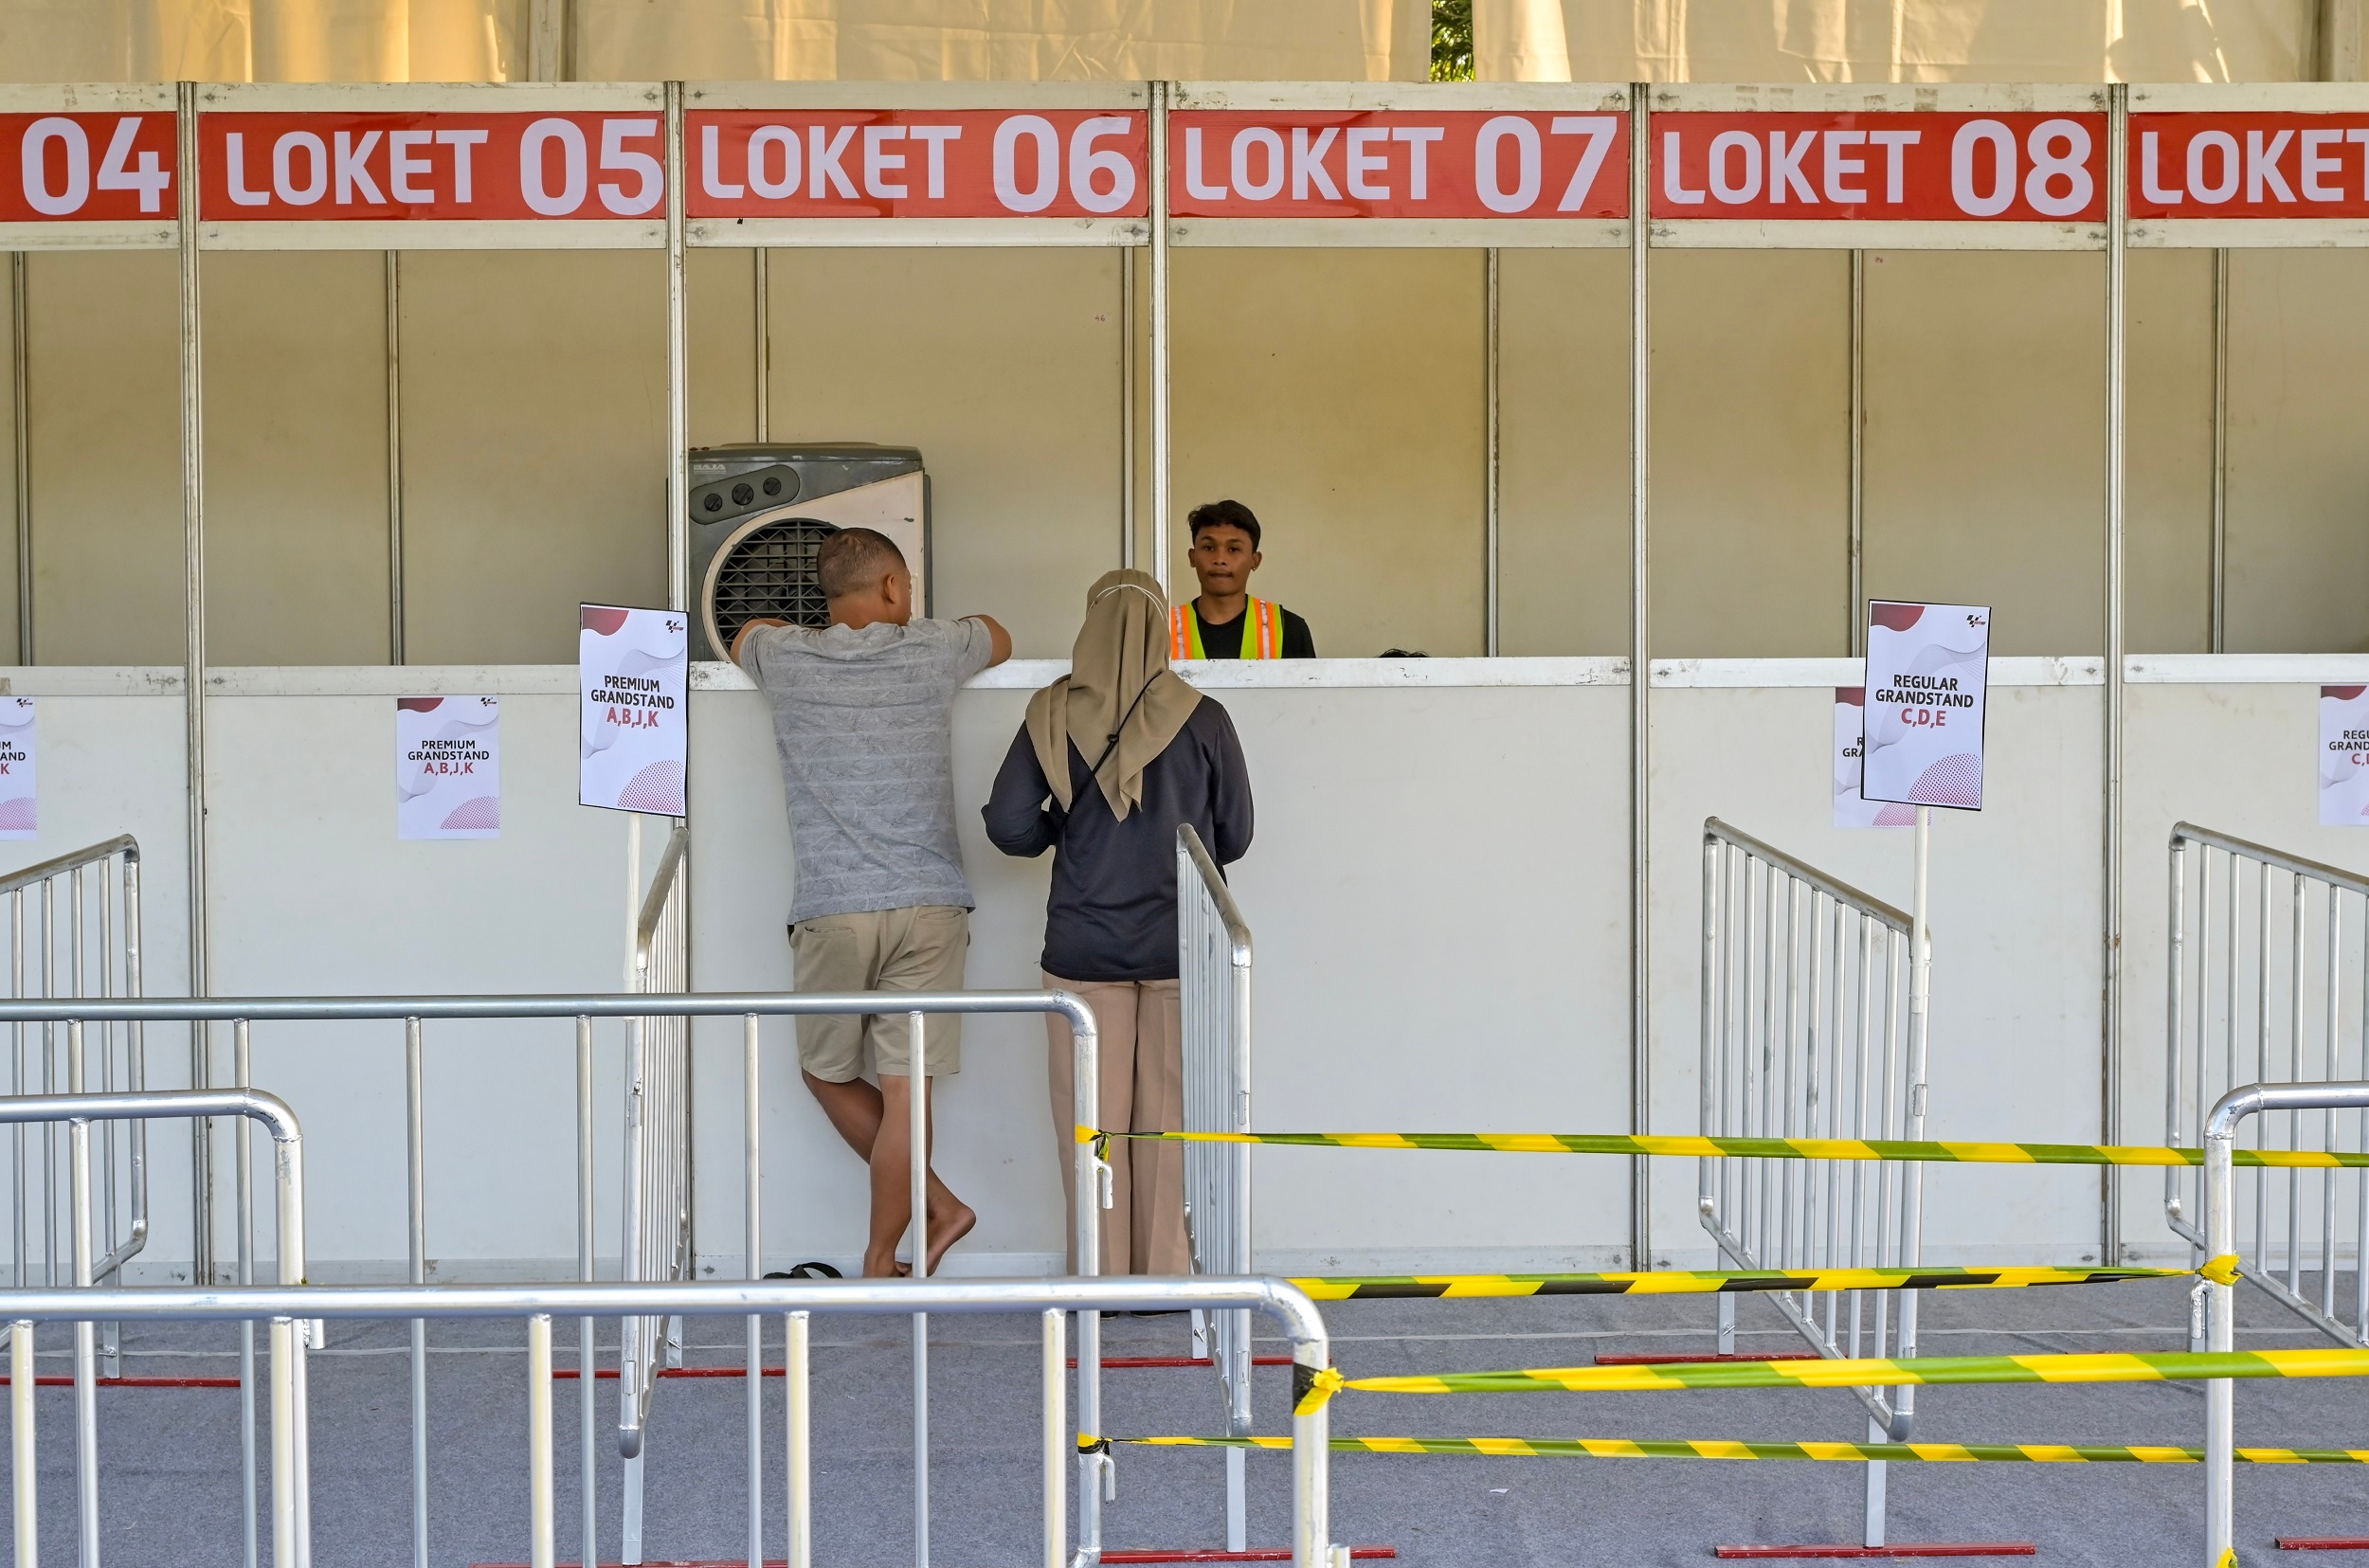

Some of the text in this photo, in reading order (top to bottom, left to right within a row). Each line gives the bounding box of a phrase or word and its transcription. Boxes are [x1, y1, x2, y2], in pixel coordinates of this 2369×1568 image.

[22, 117, 171, 215] 04
[226, 117, 664, 216] LOKET 05
[701, 115, 1136, 213] LOKET 06
[1185, 115, 1618, 212] LOKET 07
[1664, 118, 2093, 217] LOKET 08
[604, 675, 660, 693] PREMIUM
[1893, 674, 1959, 692] REGULAR
[590, 689, 675, 710] GRANDSTAND
[1875, 688, 1974, 709] GRANDSTAND
[606, 706, 660, 730] A,B,J,K
[1901, 708, 1946, 730] C,D,E
[407, 750, 490, 761] GRANDSTAND
[421, 740, 476, 750] PREMIUM
[424, 762, 474, 776] A,B,J,K
